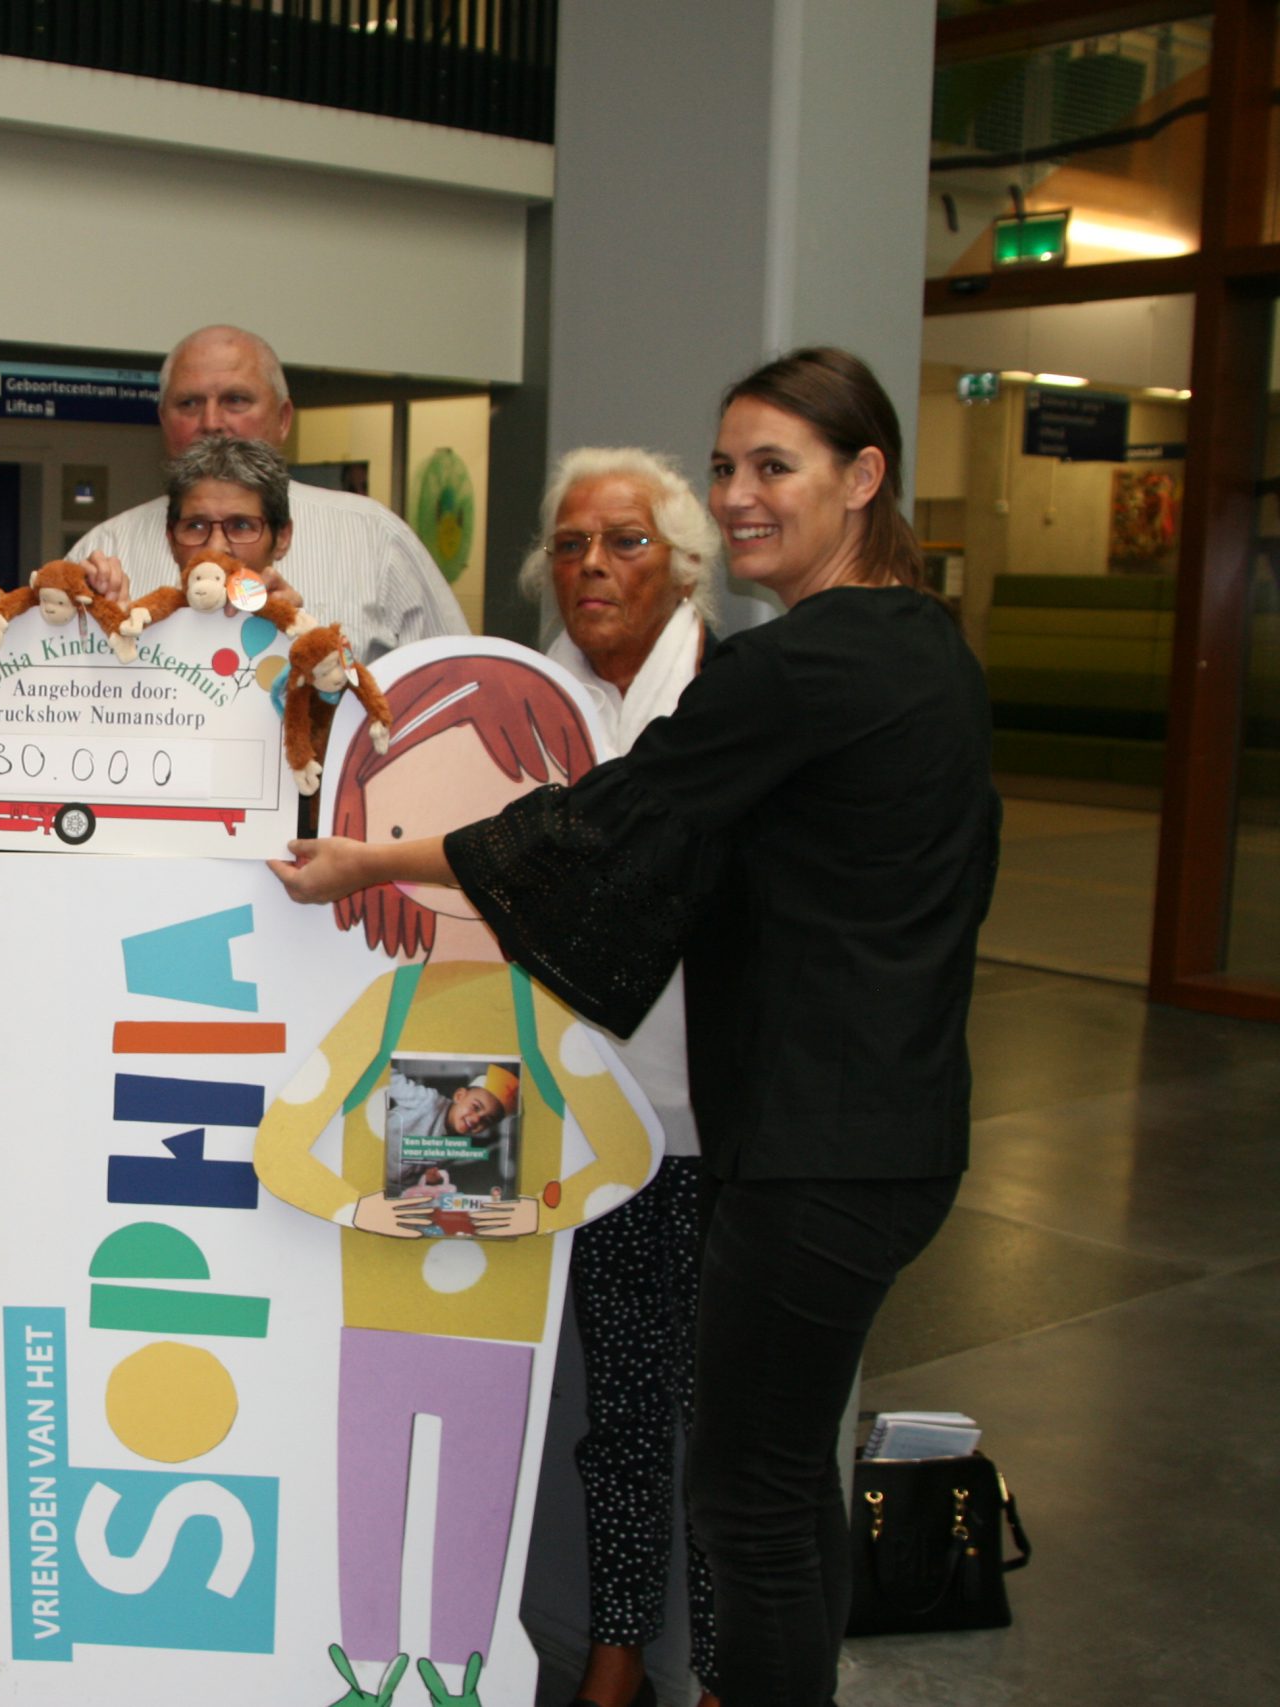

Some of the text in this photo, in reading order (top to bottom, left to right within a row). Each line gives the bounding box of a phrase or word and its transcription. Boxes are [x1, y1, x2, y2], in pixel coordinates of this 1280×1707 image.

[5, 377, 117, 398] Geboortecentrum
[138, 389, 160, 402] etag
[5, 399, 43, 415] Liften
[13, 679, 177, 700] Aangeboden door:
[91, 705, 206, 730] Numansdorp
[75, 903, 287, 1600] SOPHIA
[25, 1325, 61, 1640] VRIENDEN VAN HET
